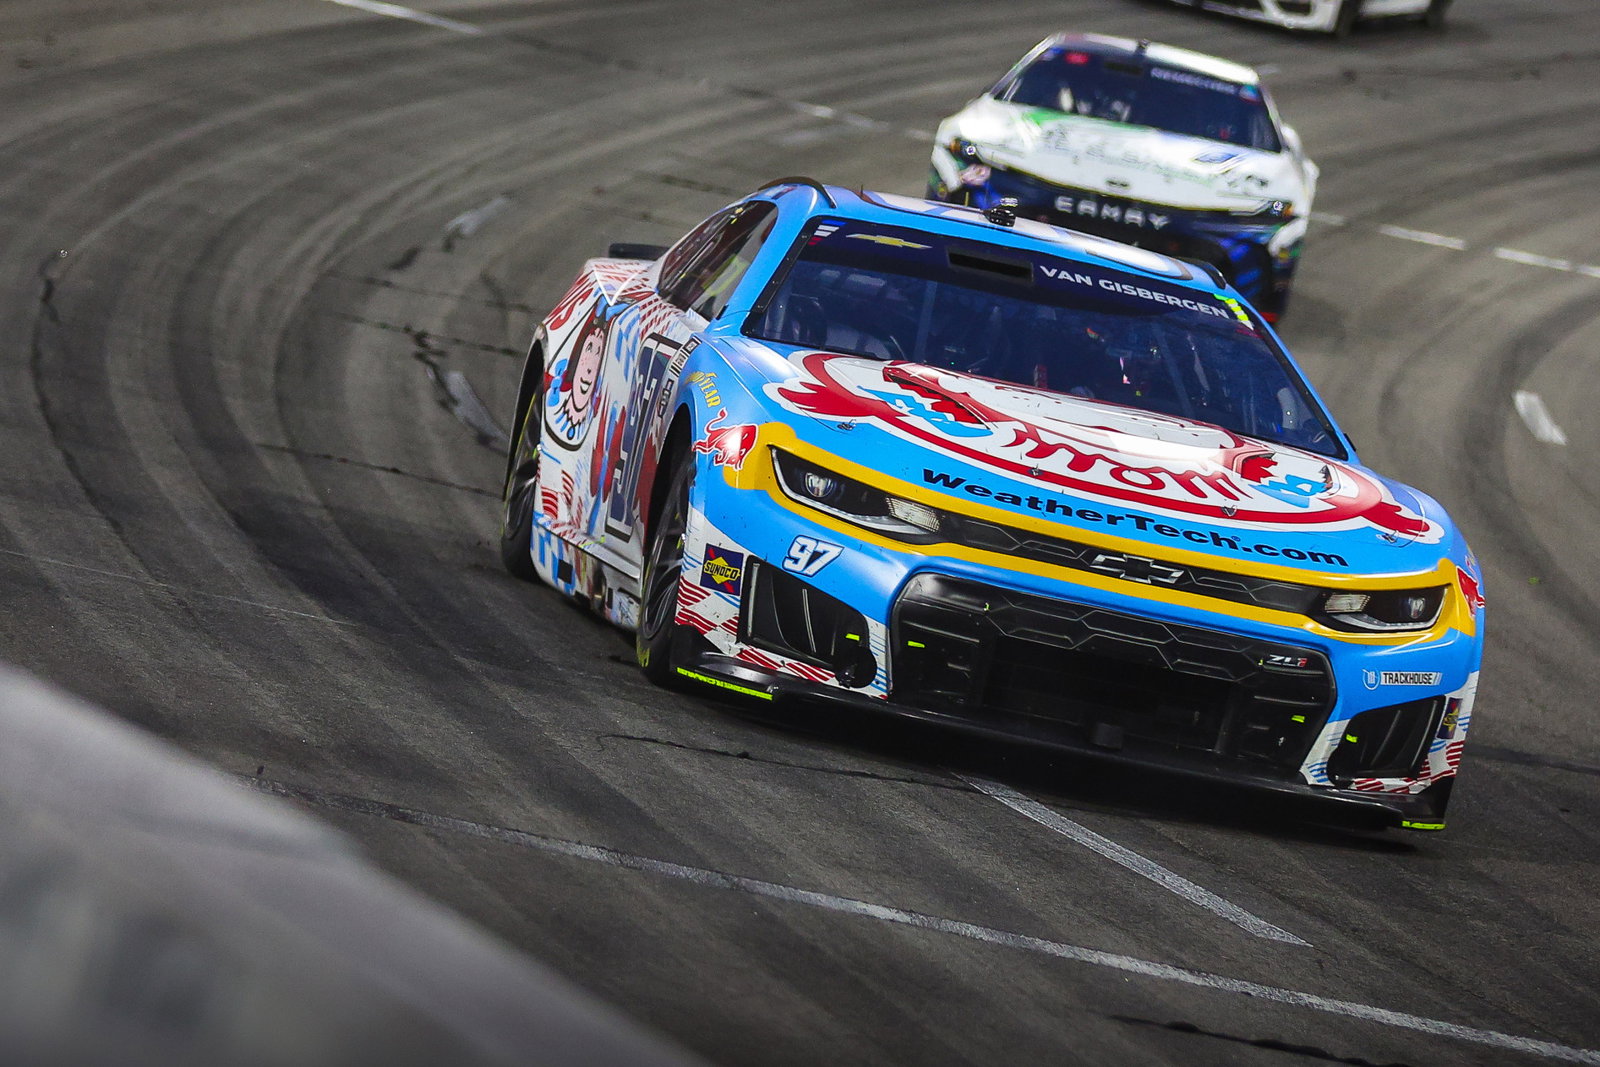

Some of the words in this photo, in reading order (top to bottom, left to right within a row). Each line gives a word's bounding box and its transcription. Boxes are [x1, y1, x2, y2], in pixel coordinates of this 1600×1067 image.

[1054, 195, 1171, 230] CAMRY
[1039, 265, 1093, 287] VAN
[1099, 279, 1229, 320] GISBERGEN
[703, 562, 740, 580] SUNOCO
[782, 535, 844, 577] 97
[1383, 672, 1433, 685] TRACKHOUSE
